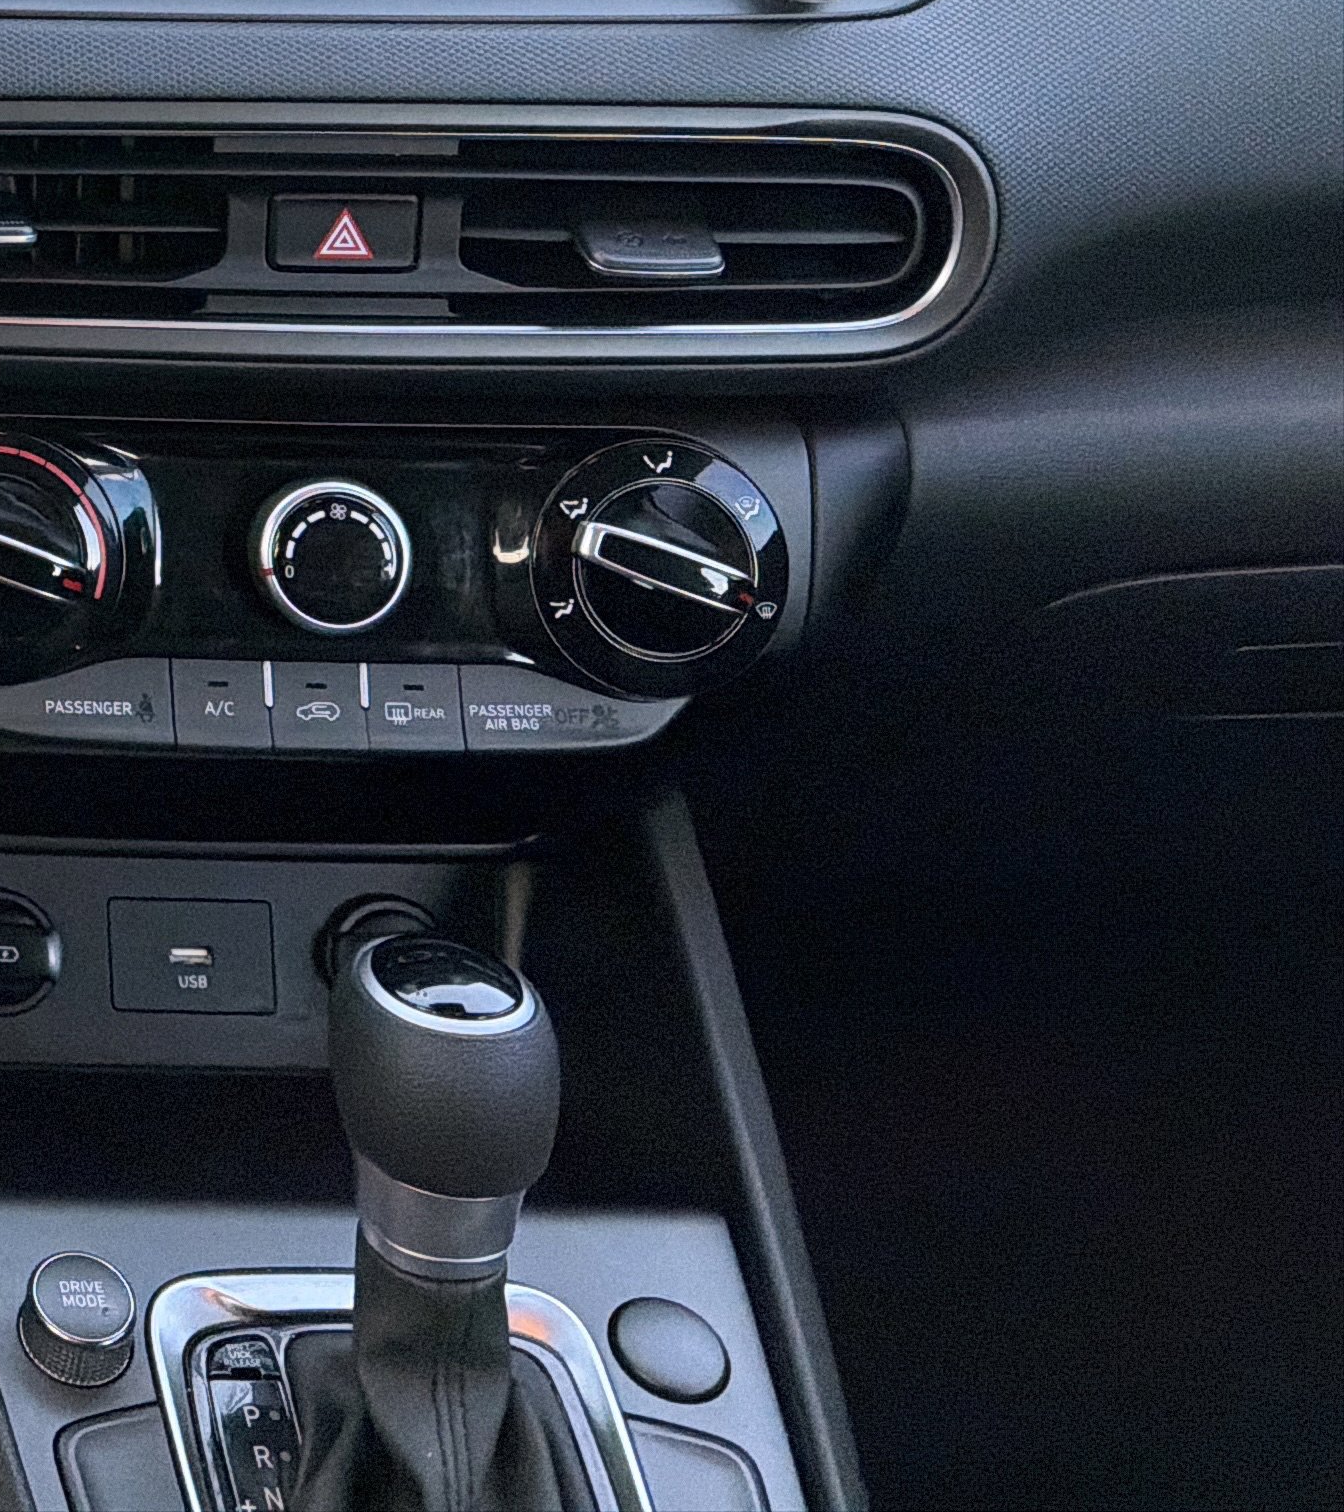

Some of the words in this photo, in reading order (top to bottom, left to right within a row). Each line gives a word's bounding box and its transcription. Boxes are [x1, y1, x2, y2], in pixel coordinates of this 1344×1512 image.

[284, 564, 295, 579] 0
[45, 700, 133, 716] PASSENGER
[204, 701, 235, 717] A/C
[413, 707, 445, 720] REAR
[469, 703, 553, 718] PASSENGER
[484, 718, 508, 731] AIR
[511, 717, 540, 731] BAG
[554, 709, 590, 726] OFF
[177, 974, 208, 989] USB
[58, 1280, 105, 1294] DRIVE
[61, 1294, 107, 1308] MODE
[242, 1405, 260, 1428] P
[253, 1445, 275, 1469] R
[263, 1486, 285, 1511] N
